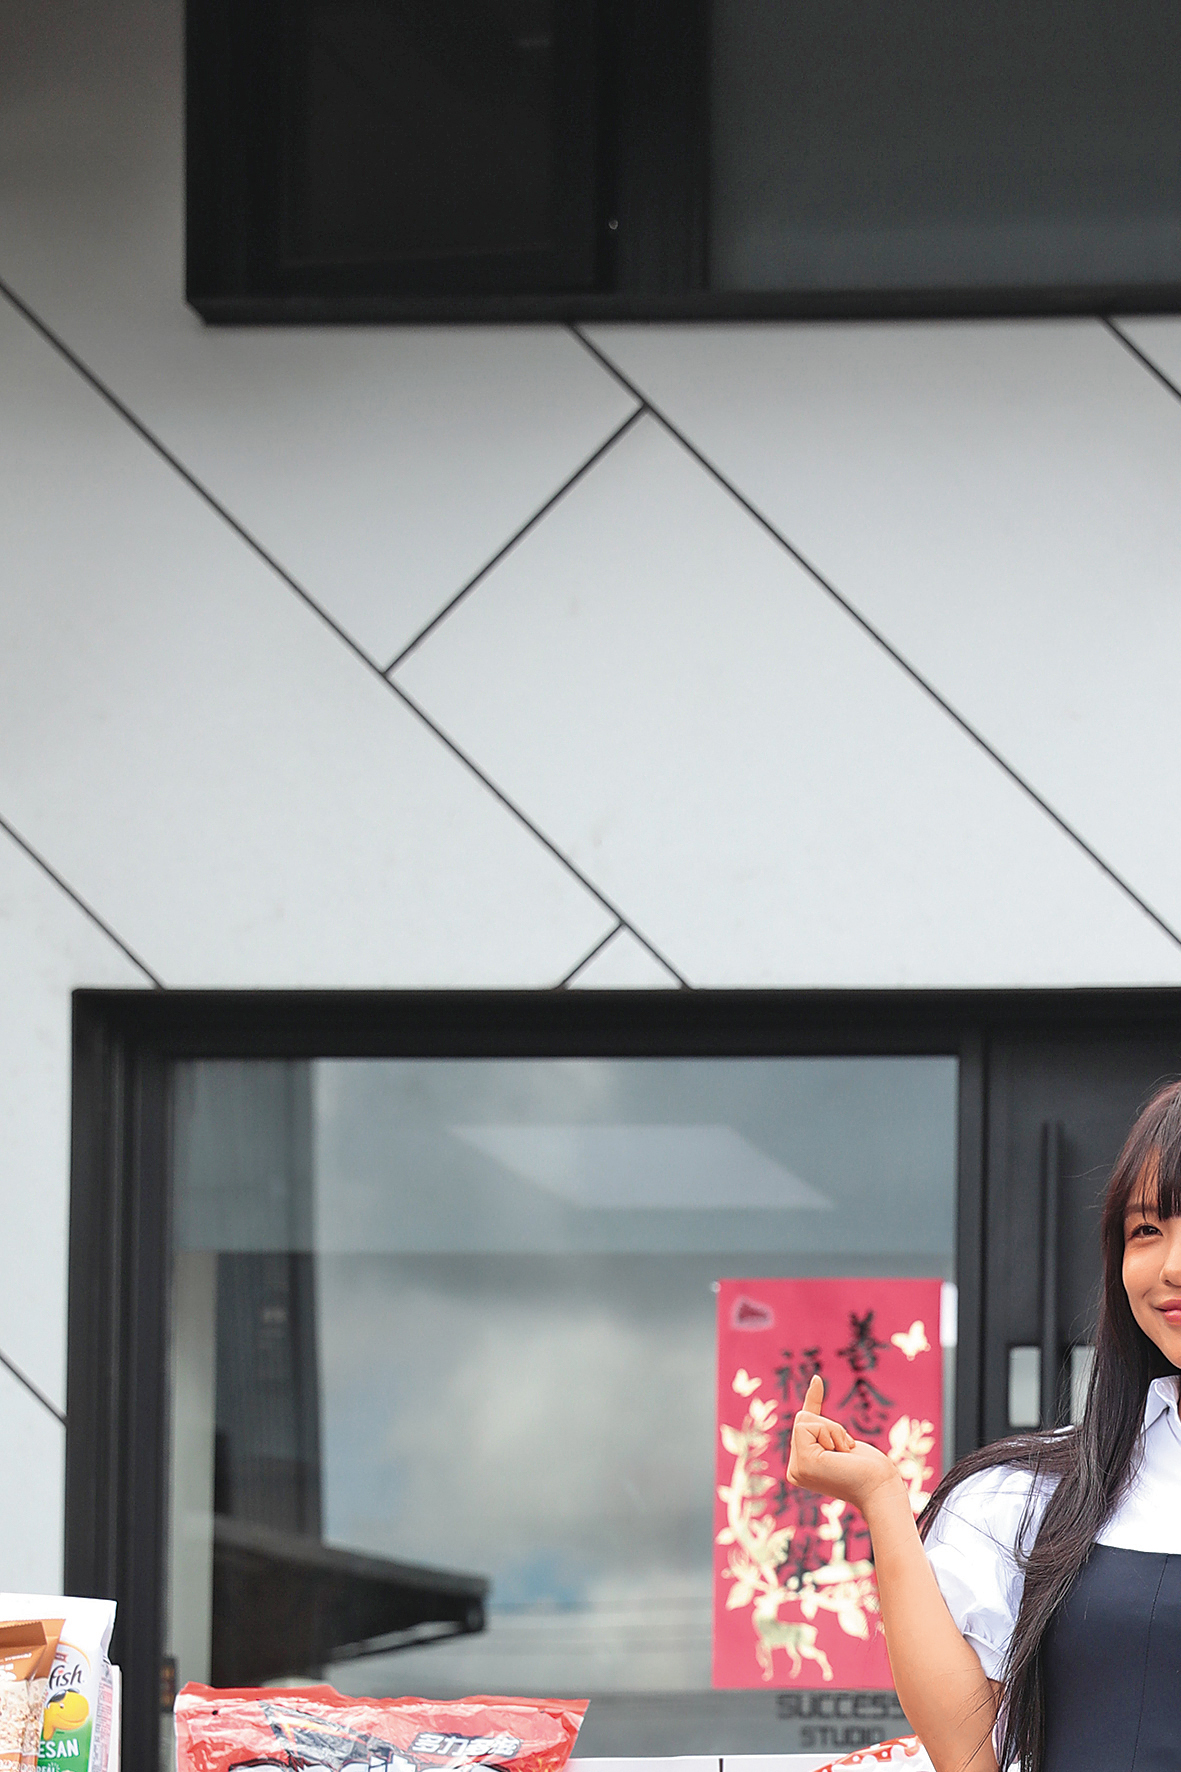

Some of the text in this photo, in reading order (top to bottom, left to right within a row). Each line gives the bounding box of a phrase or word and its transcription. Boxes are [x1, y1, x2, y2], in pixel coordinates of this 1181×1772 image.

[49, 1664, 81, 1690] fish
[802, 1726, 887, 1747] STUDIO
[39, 1739, 80, 1759] ESAN
